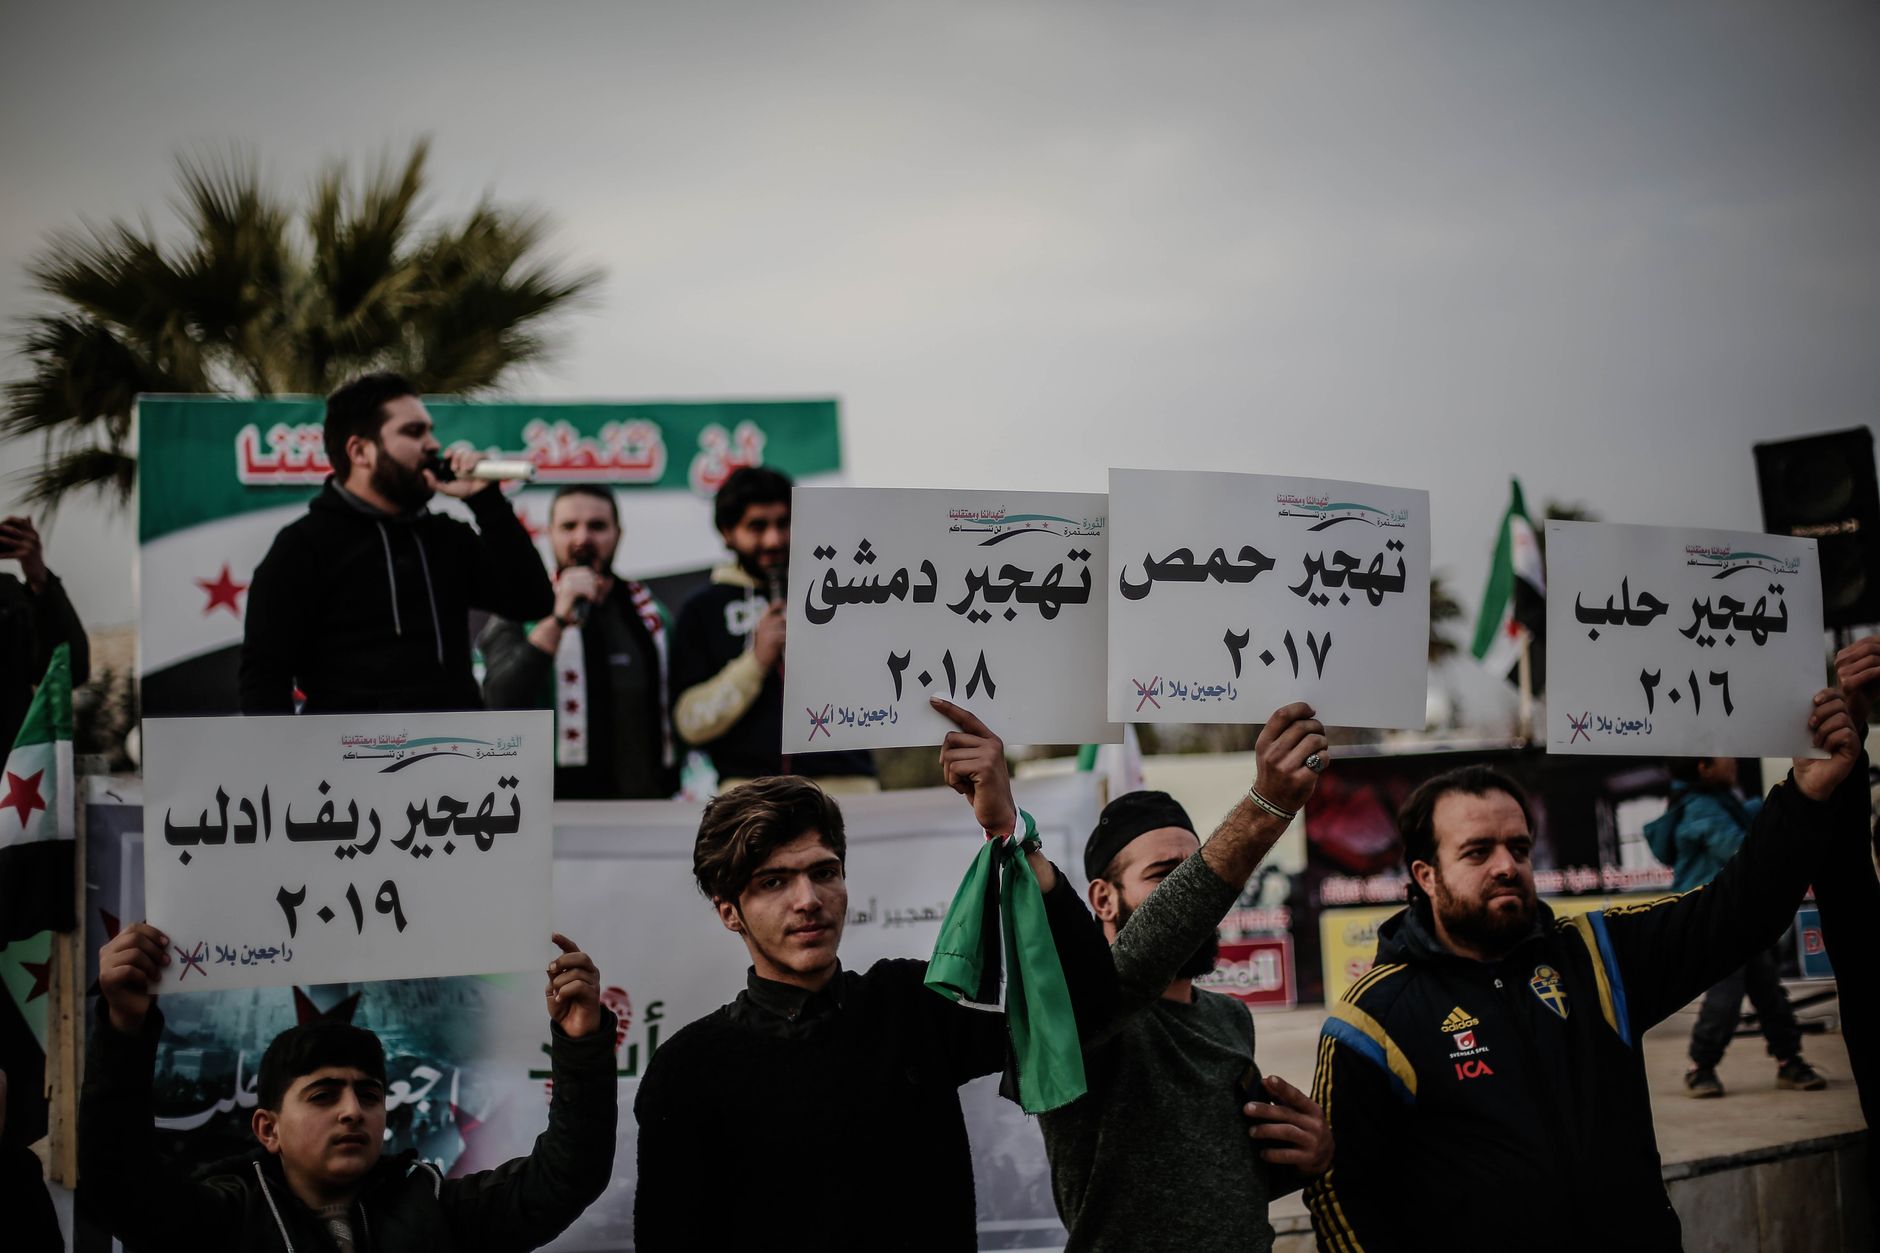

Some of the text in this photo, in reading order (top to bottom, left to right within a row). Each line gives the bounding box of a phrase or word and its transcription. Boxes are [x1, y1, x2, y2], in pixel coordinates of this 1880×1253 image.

[486, 419, 666, 492] تنطف
[1082, 517, 1105, 530] الثورة
[1320, 512, 1327, 520] لن
[1377, 517, 1405, 528] مستمرة
[1391, 509, 1409, 521] الثورة
[993, 526, 1002, 534] لن
[1063, 527, 1100, 538] مستمرة
[805, 538, 937, 624] دمشق
[1120, 539, 1406, 607] تهجير حمص
[946, 549, 1091, 623] تهجير
[1575, 576, 1788, 648] تهجير حلب
[1223, 628, 1332, 680] ٢٠١٧
[887, 649, 996, 701] ٢٠١٨
[1137, 677, 1237, 702] راجعين بلا أسد
[1640, 669, 1734, 716] ٢٠١٦
[811, 704, 898, 727] راجعين بلا أسد
[1571, 712, 1652, 735] راجعين بلا أسد
[476, 748, 517, 760] مستمرة
[497, 735, 522, 751] الثورة
[396, 752, 404, 760] لن
[165, 776, 520, 865] تهجير ريف ادلب
[276, 880, 407, 938] ٢٠١٩
[180, 942, 293, 966] راجعين بلا أسد
[1441, 1018, 1480, 1034] adidas
[1449, 1046, 1490, 1059] SVENSKA SPEL
[1455, 1059, 1495, 1081] ICA
